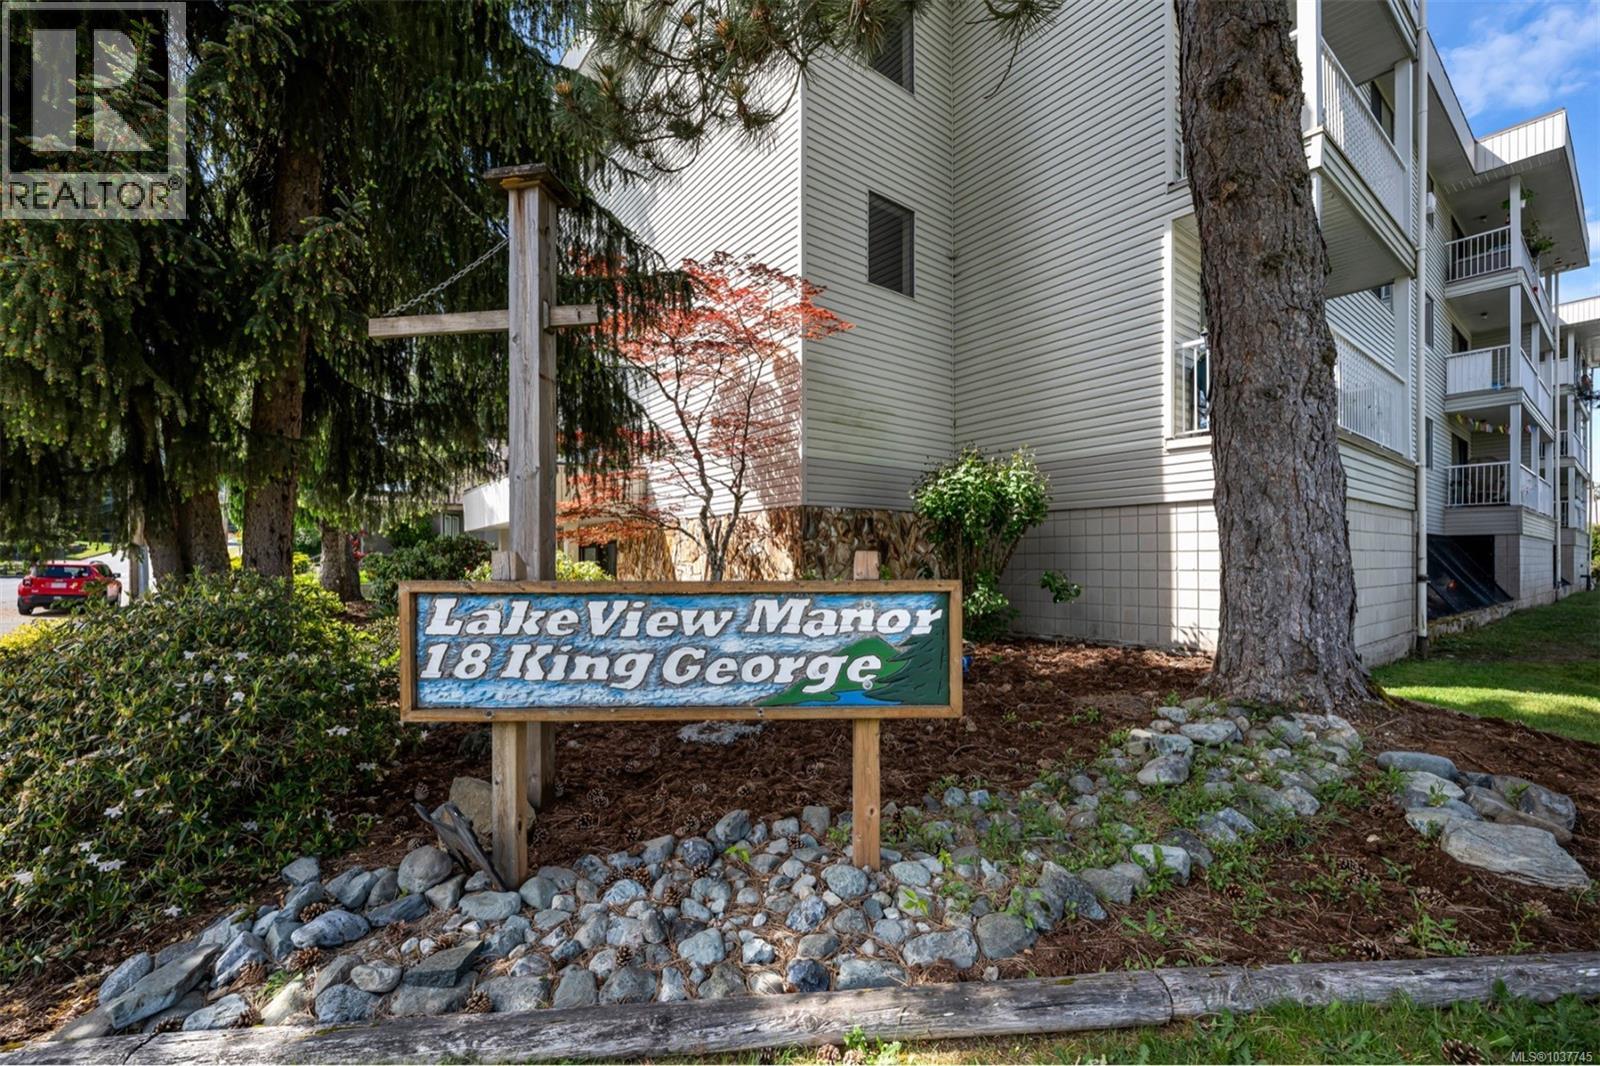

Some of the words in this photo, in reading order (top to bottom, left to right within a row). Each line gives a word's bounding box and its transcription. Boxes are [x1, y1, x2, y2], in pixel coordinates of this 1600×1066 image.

[745, 598, 943, 638] Manor
[420, 643, 491, 680] 18
[500, 644, 654, 690] King
[662, 647, 882, 693] George
